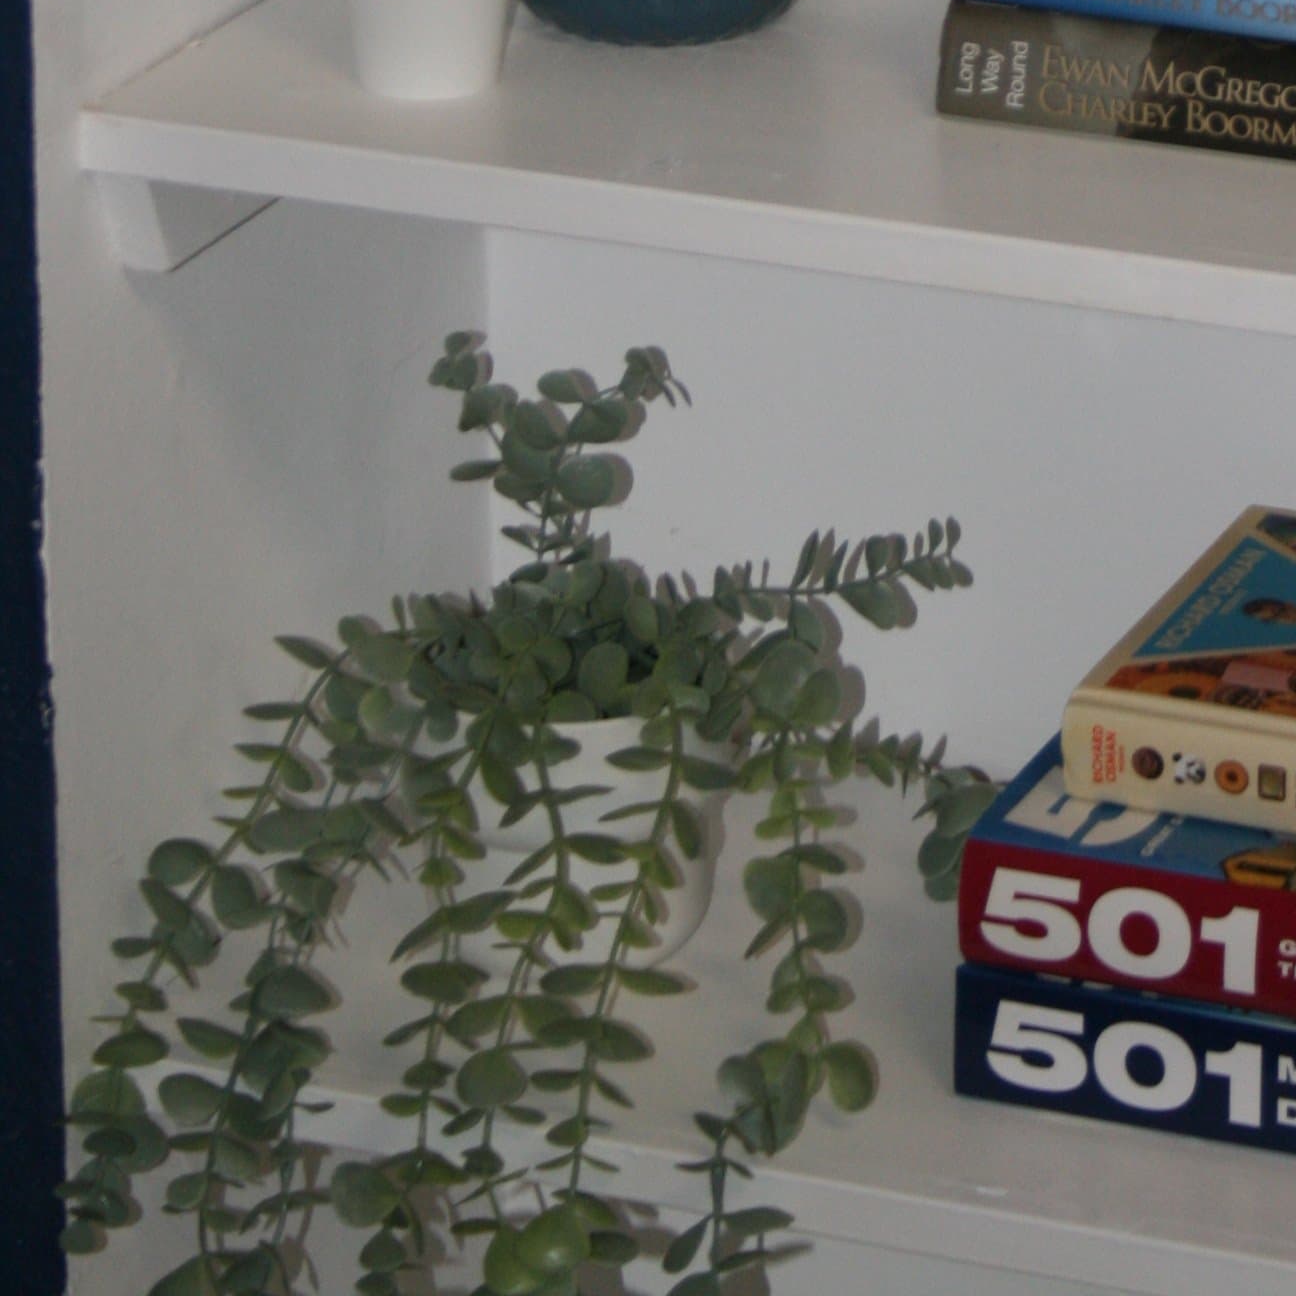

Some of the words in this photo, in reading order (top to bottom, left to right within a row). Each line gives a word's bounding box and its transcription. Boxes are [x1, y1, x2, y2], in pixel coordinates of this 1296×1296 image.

[955, 40, 981, 95] Long
[980, 47, 1005, 95] Way
[1005, 40, 1029, 108] Round
[1041, 45, 1131, 90] EWAN
[1038, 81, 1177, 134] CHARLEY
[980, 866, 1260, 996] 501
[986, 999, 1262, 1129] 501
